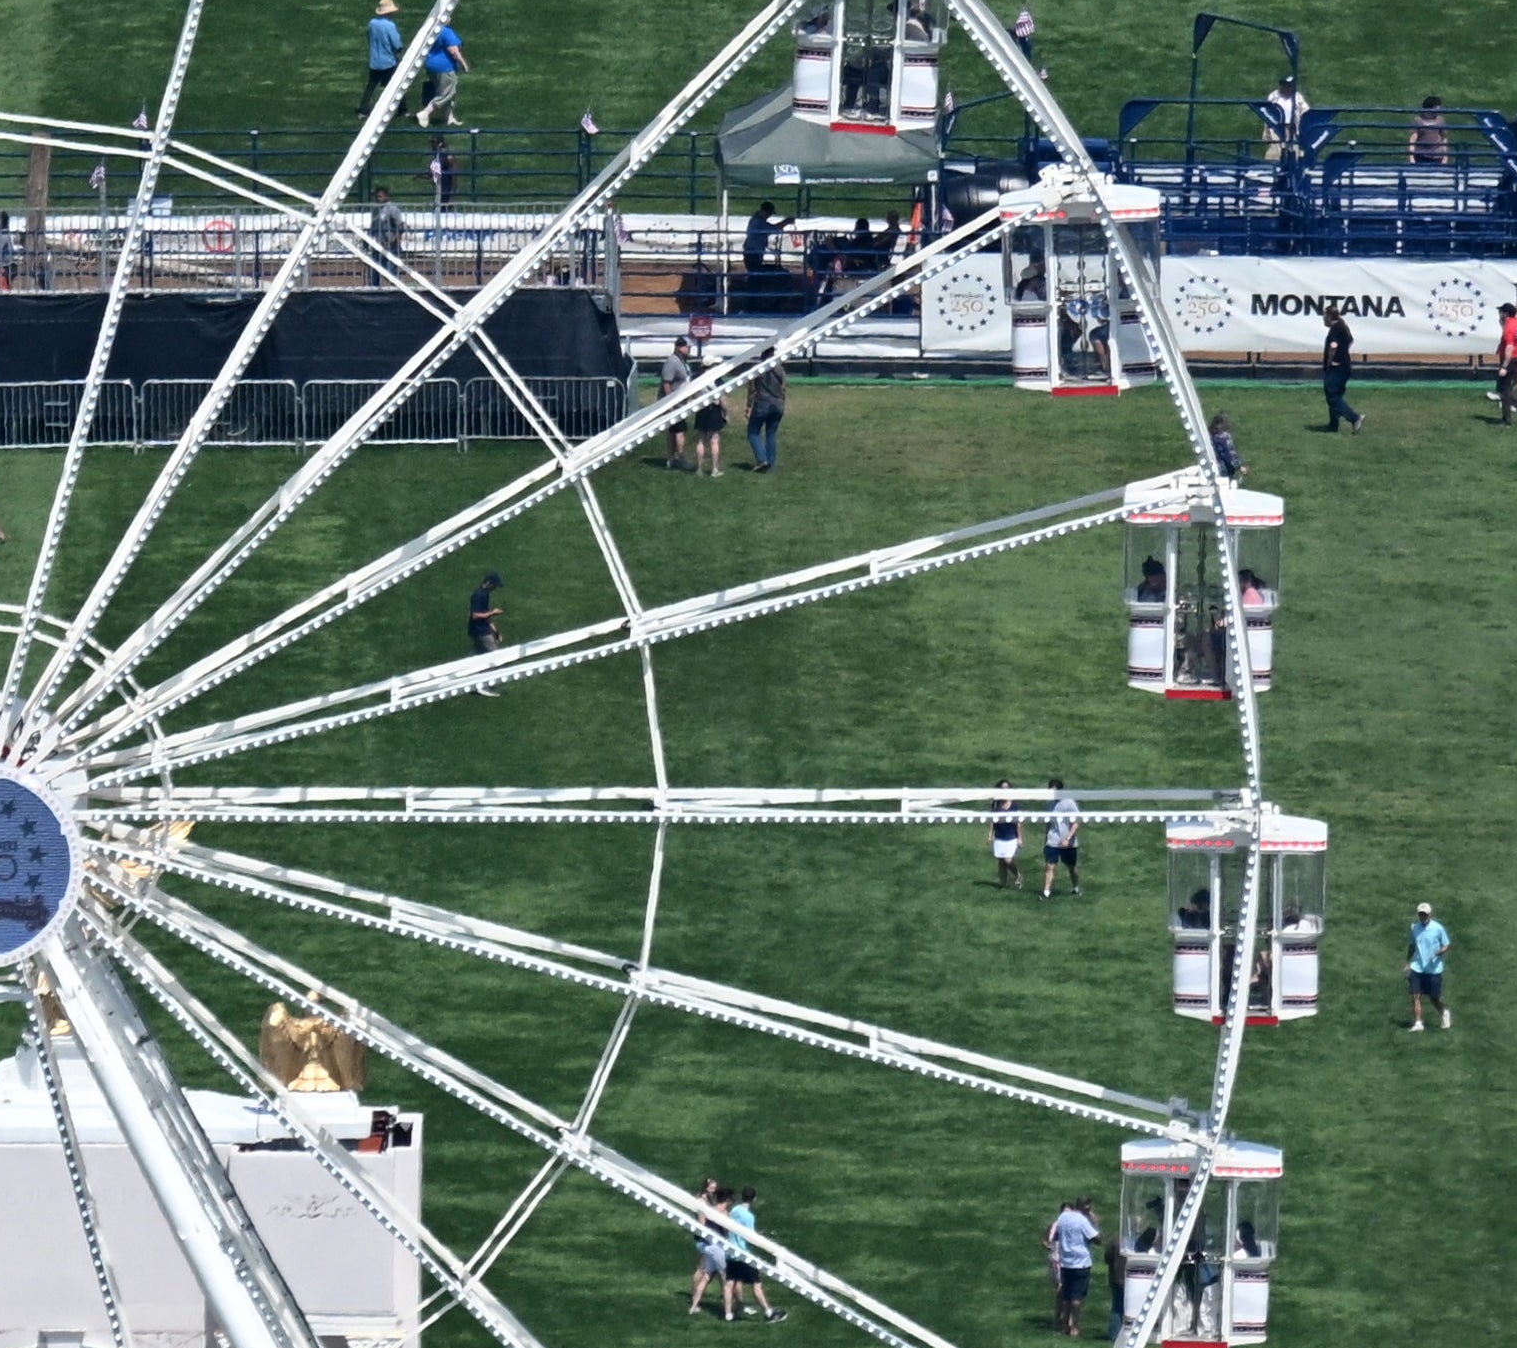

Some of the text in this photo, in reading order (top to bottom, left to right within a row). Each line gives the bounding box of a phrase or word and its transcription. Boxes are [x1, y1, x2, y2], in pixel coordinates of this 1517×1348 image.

[774, 164, 798, 175] USDA
[950, 299, 984, 317] 250
[1188, 300, 1221, 318] 250
[1251, 294, 1405, 318] MONTANA
[1439, 304, 1474, 319] 250
